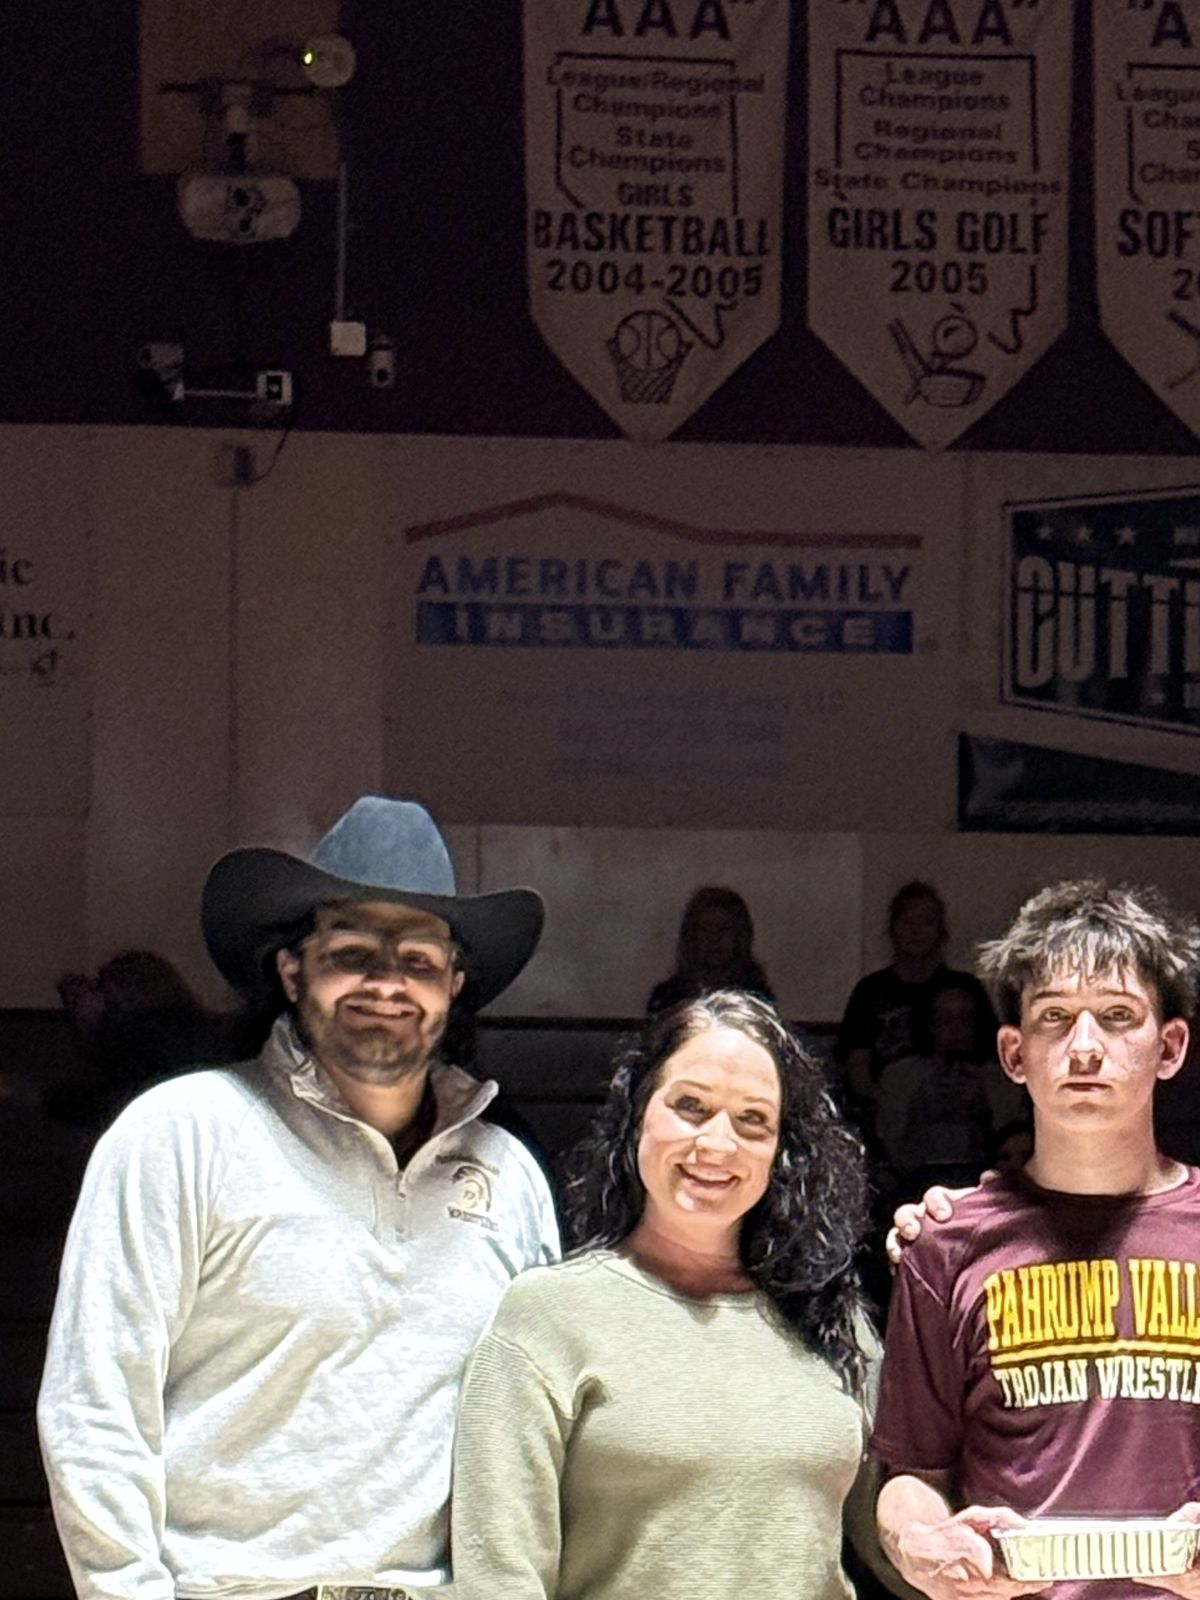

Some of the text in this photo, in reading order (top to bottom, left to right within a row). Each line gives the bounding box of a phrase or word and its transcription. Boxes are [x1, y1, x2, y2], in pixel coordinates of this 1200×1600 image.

[886, 62, 984, 89] League
[573, 93, 722, 121] Champions
[860, 86, 1010, 112] Champions
[616, 126, 695, 148] State
[874, 120, 1003, 143] Regional
[570, 146, 725, 174] Champions
[854, 142, 1017, 164] Champions
[617, 183, 694, 206] GIRLS
[815, 169, 1061, 196] State Champions
[534, 210, 771, 256] BASKETBALL
[828, 207, 1049, 254] GIRLS GOLF
[546, 260, 763, 298] 2004-2005
[890, 260, 988, 294] 2005
[416, 554, 911, 602] AMERICAN FAMILY
[455, 607, 876, 647] INSURANCE
[984, 1259, 1120, 1350] PAHRUMP
[993, 1358, 1088, 1409] TROJAN
